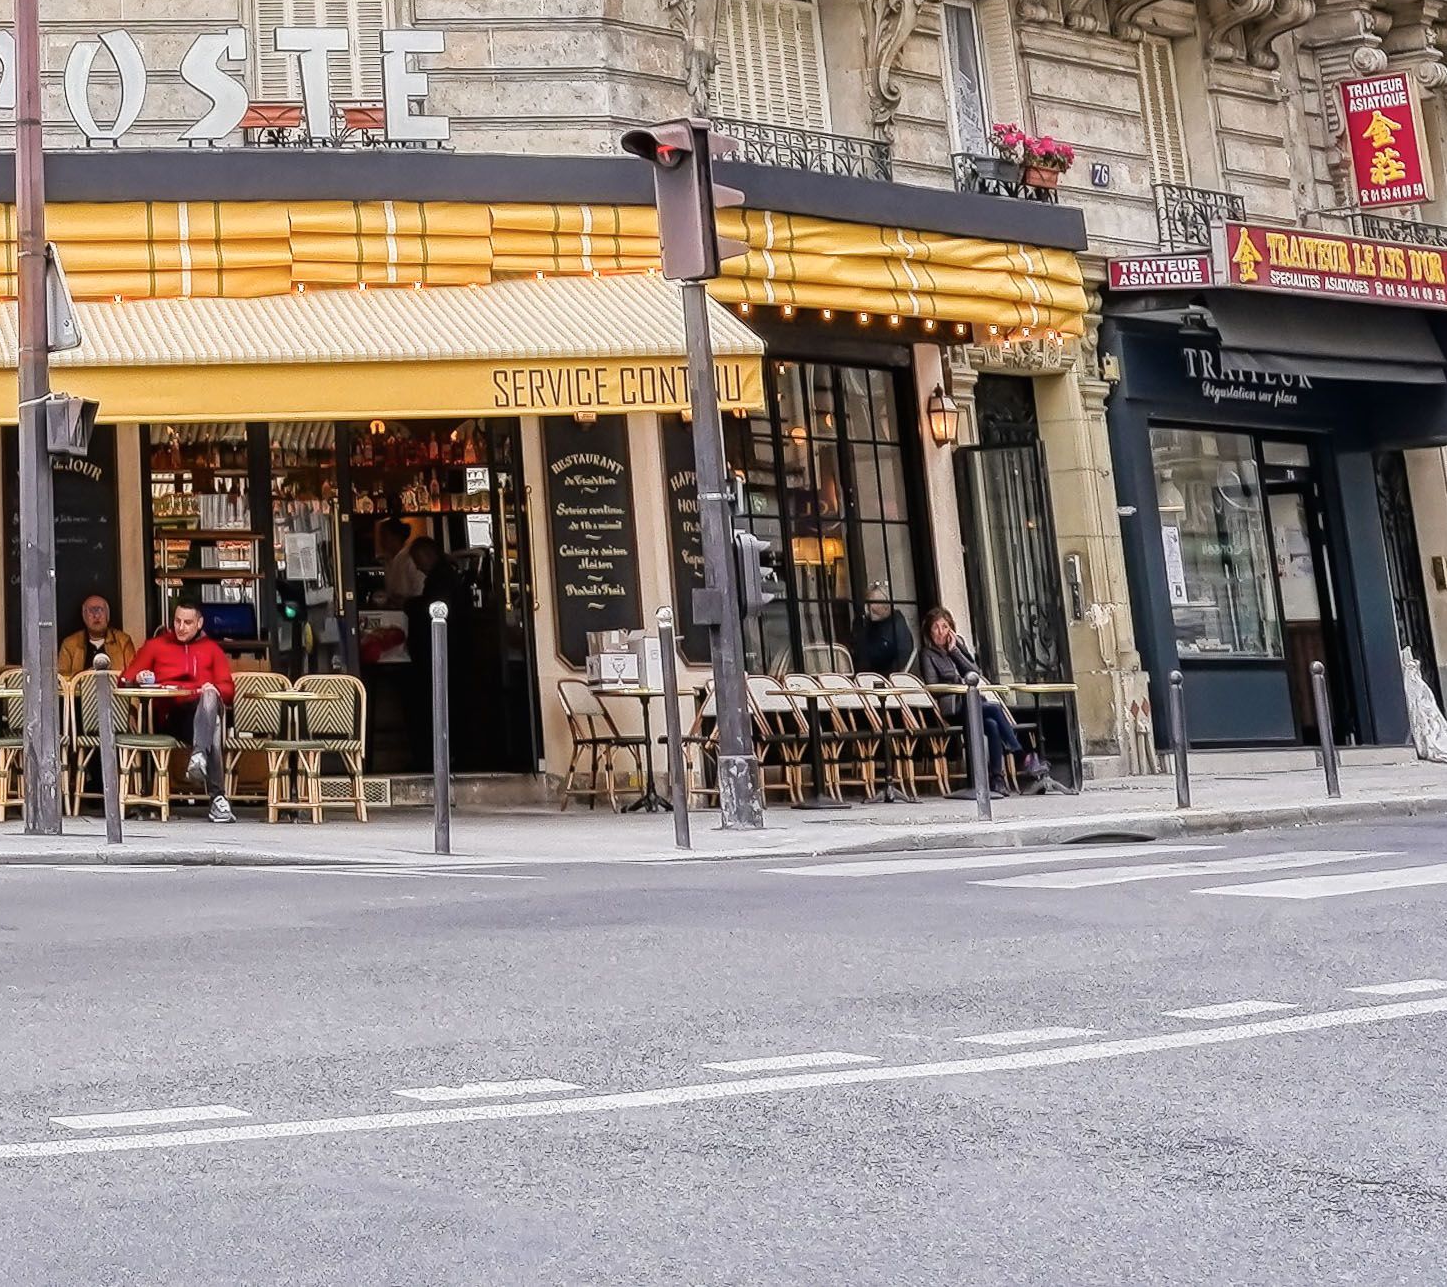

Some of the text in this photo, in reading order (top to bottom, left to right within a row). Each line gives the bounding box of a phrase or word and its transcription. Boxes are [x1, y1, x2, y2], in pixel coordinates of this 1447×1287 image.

[1347, 78, 1404, 98] TRAITEUR
[1349, 92, 1407, 113] ASIATIQUE
[1094, 164, 1108, 184] 76
[1119, 258, 1200, 274] TRAITEUR
[1265, 231, 1445, 285] TRAITEUR LE LYS D'OR
[1119, 271, 1203, 286] ASIATIQUE
[1269, 270, 1321, 289] SPECIALITES
[1324, 277, 1370, 294] ASIATIQUES
[493, 364, 741, 408] SERVICE CONTU
[1274, 389, 1298, 407] place
[65, 456, 103, 481] JOUR
[551, 453, 624, 475] RESTAURANT
